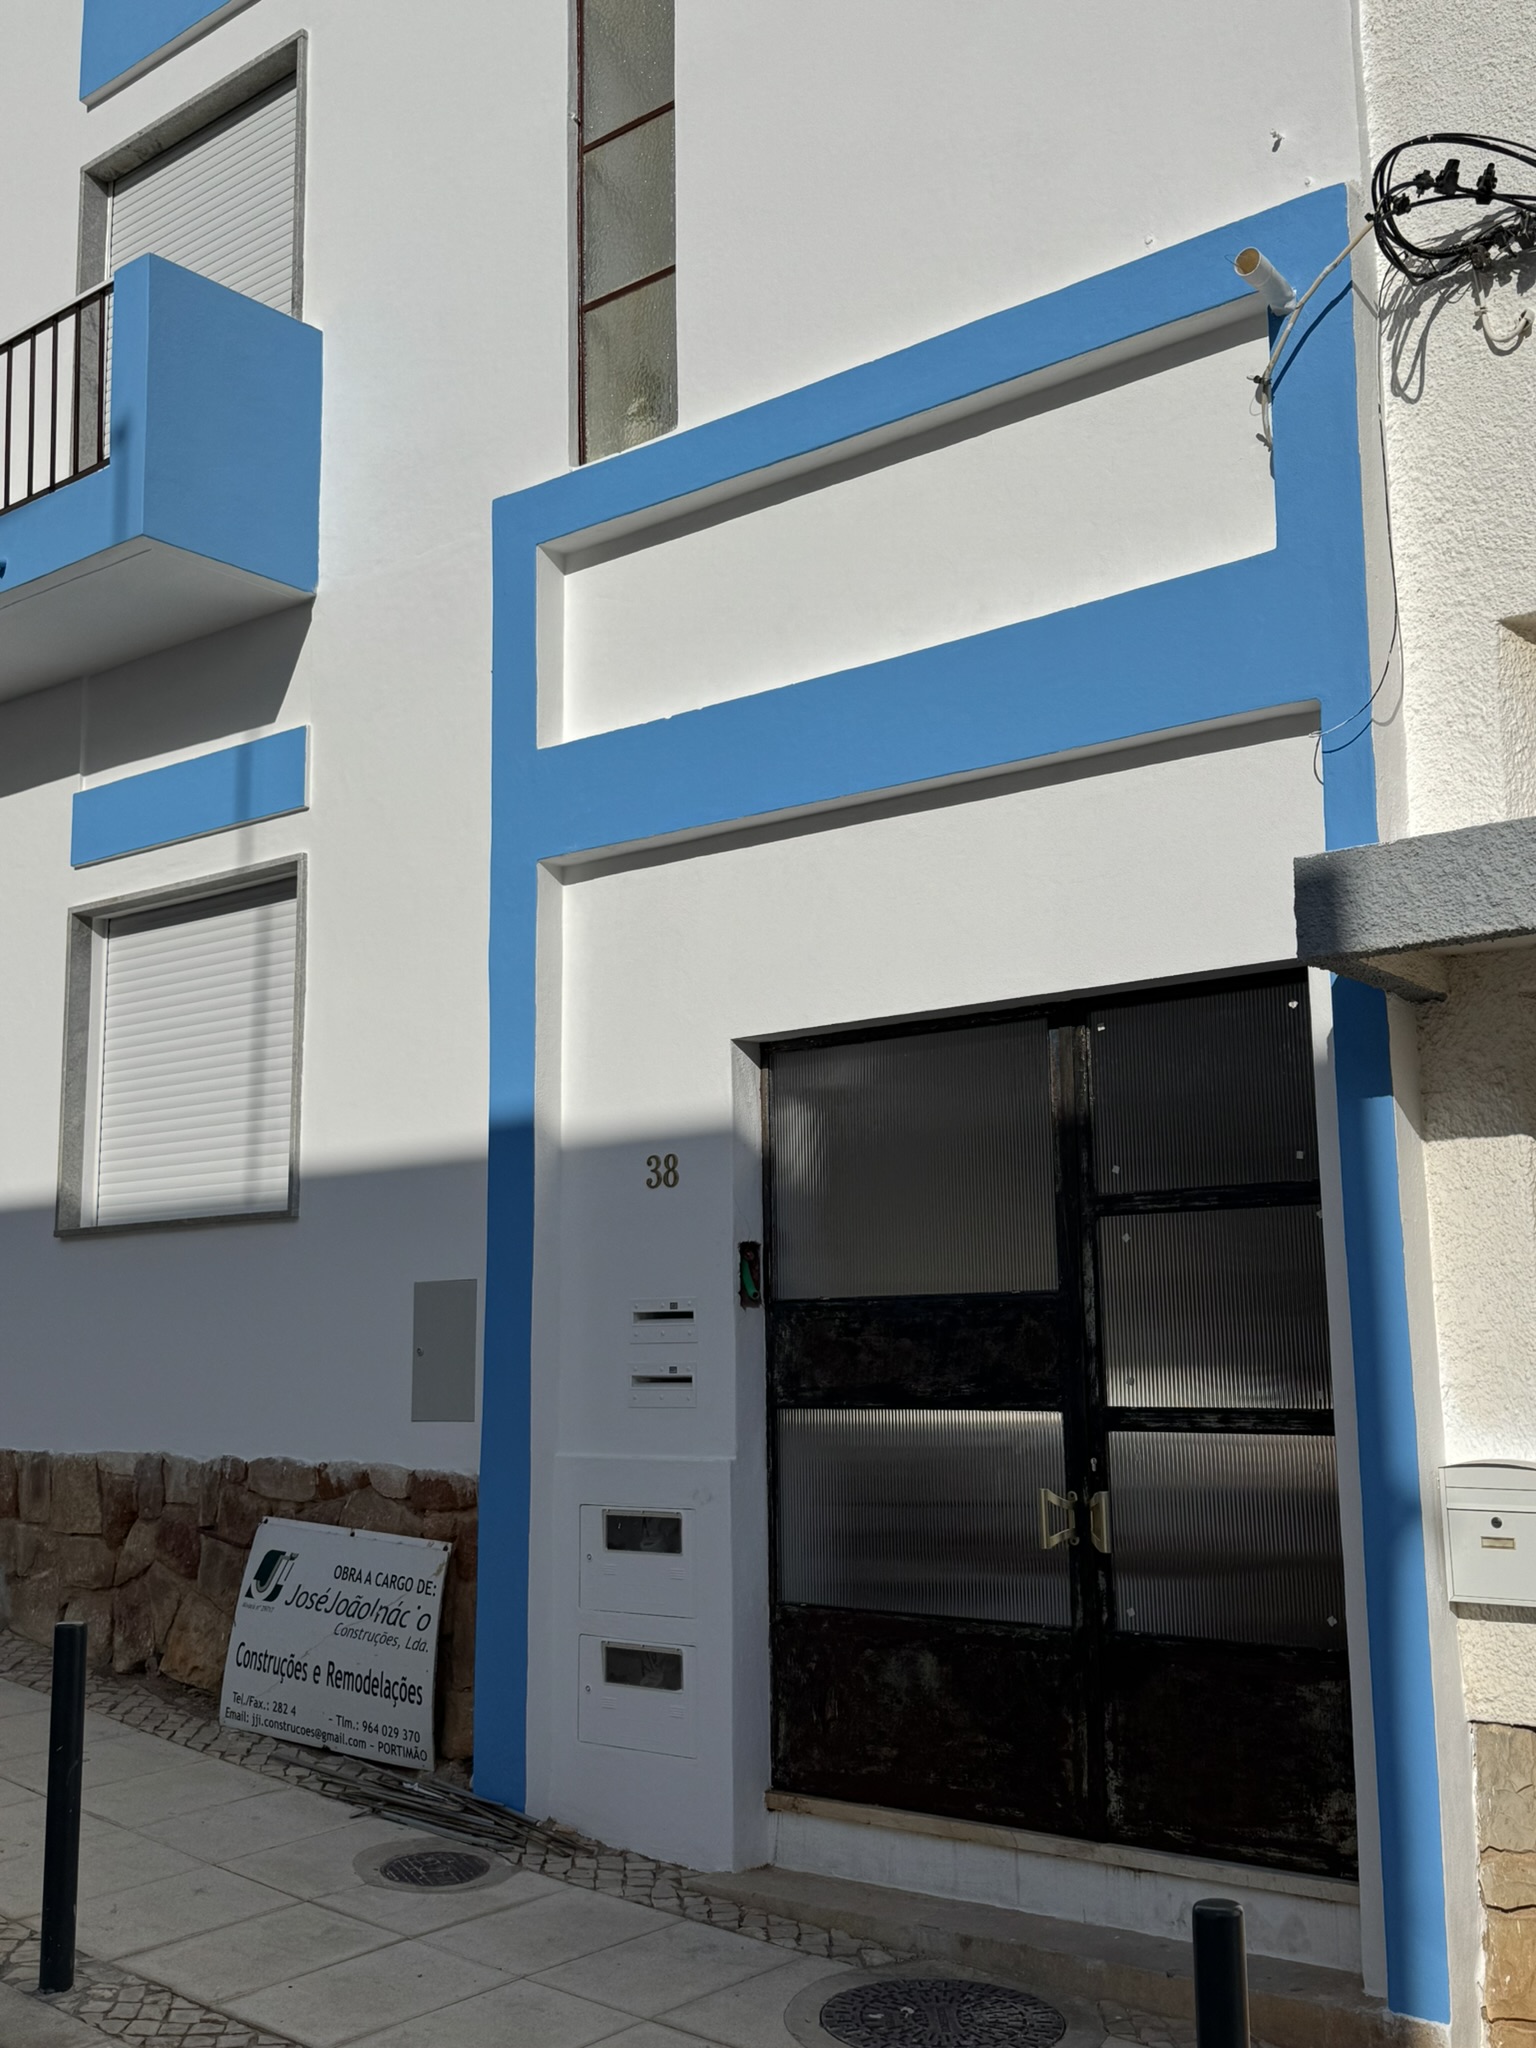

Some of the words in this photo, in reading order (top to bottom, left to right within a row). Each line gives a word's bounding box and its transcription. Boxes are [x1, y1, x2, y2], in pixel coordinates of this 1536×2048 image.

[646, 1153, 680, 1189] 38
[333, 1565, 362, 1585] OBRA
[363, 1570, 372, 1586] A
[375, 1572, 414, 1592] CARGO
[416, 1578, 437, 1597] DE:
[333, 1622, 401, 1650] Construções,
[405, 1636, 429, 1653] Lda.
[235, 1641, 308, 1684] Construções
[312, 1664, 321, 1684] e
[326, 1660, 423, 1708] Remodelações
[225, 1706, 250, 1723] Email:
[251, 1712, 367, 1750] jji.construcoes@gmail.com
[377, 1740, 428, 1762] PORTIMÃO
[232, 1691, 270, 1711] Tel./Fax.:
[272, 1700, 289, 1715] 282
[290, 1705, 297, 1717] 4
[335, 1714, 359, 1731] Tlm.:
[362, 1720, 379, 1735] 964
[381, 1724, 400, 1739] 029
[402, 1728, 421, 1743] 370
